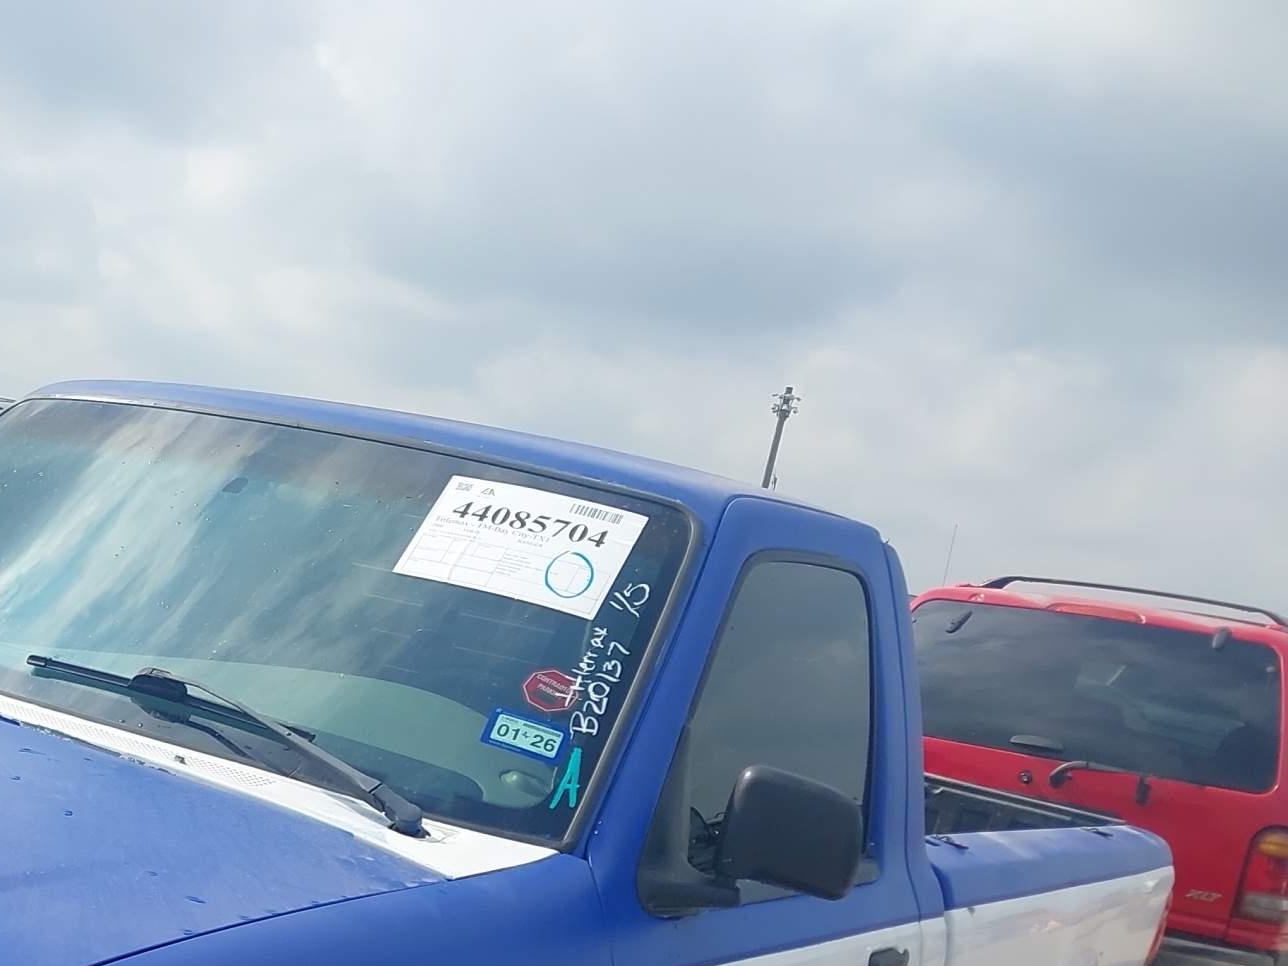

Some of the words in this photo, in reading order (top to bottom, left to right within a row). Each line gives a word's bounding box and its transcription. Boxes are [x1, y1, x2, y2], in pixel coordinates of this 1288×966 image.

[452, 501, 609, 548] 44085704
[569, 641, 630, 740] B20137
[549, 747, 581, 809] A
